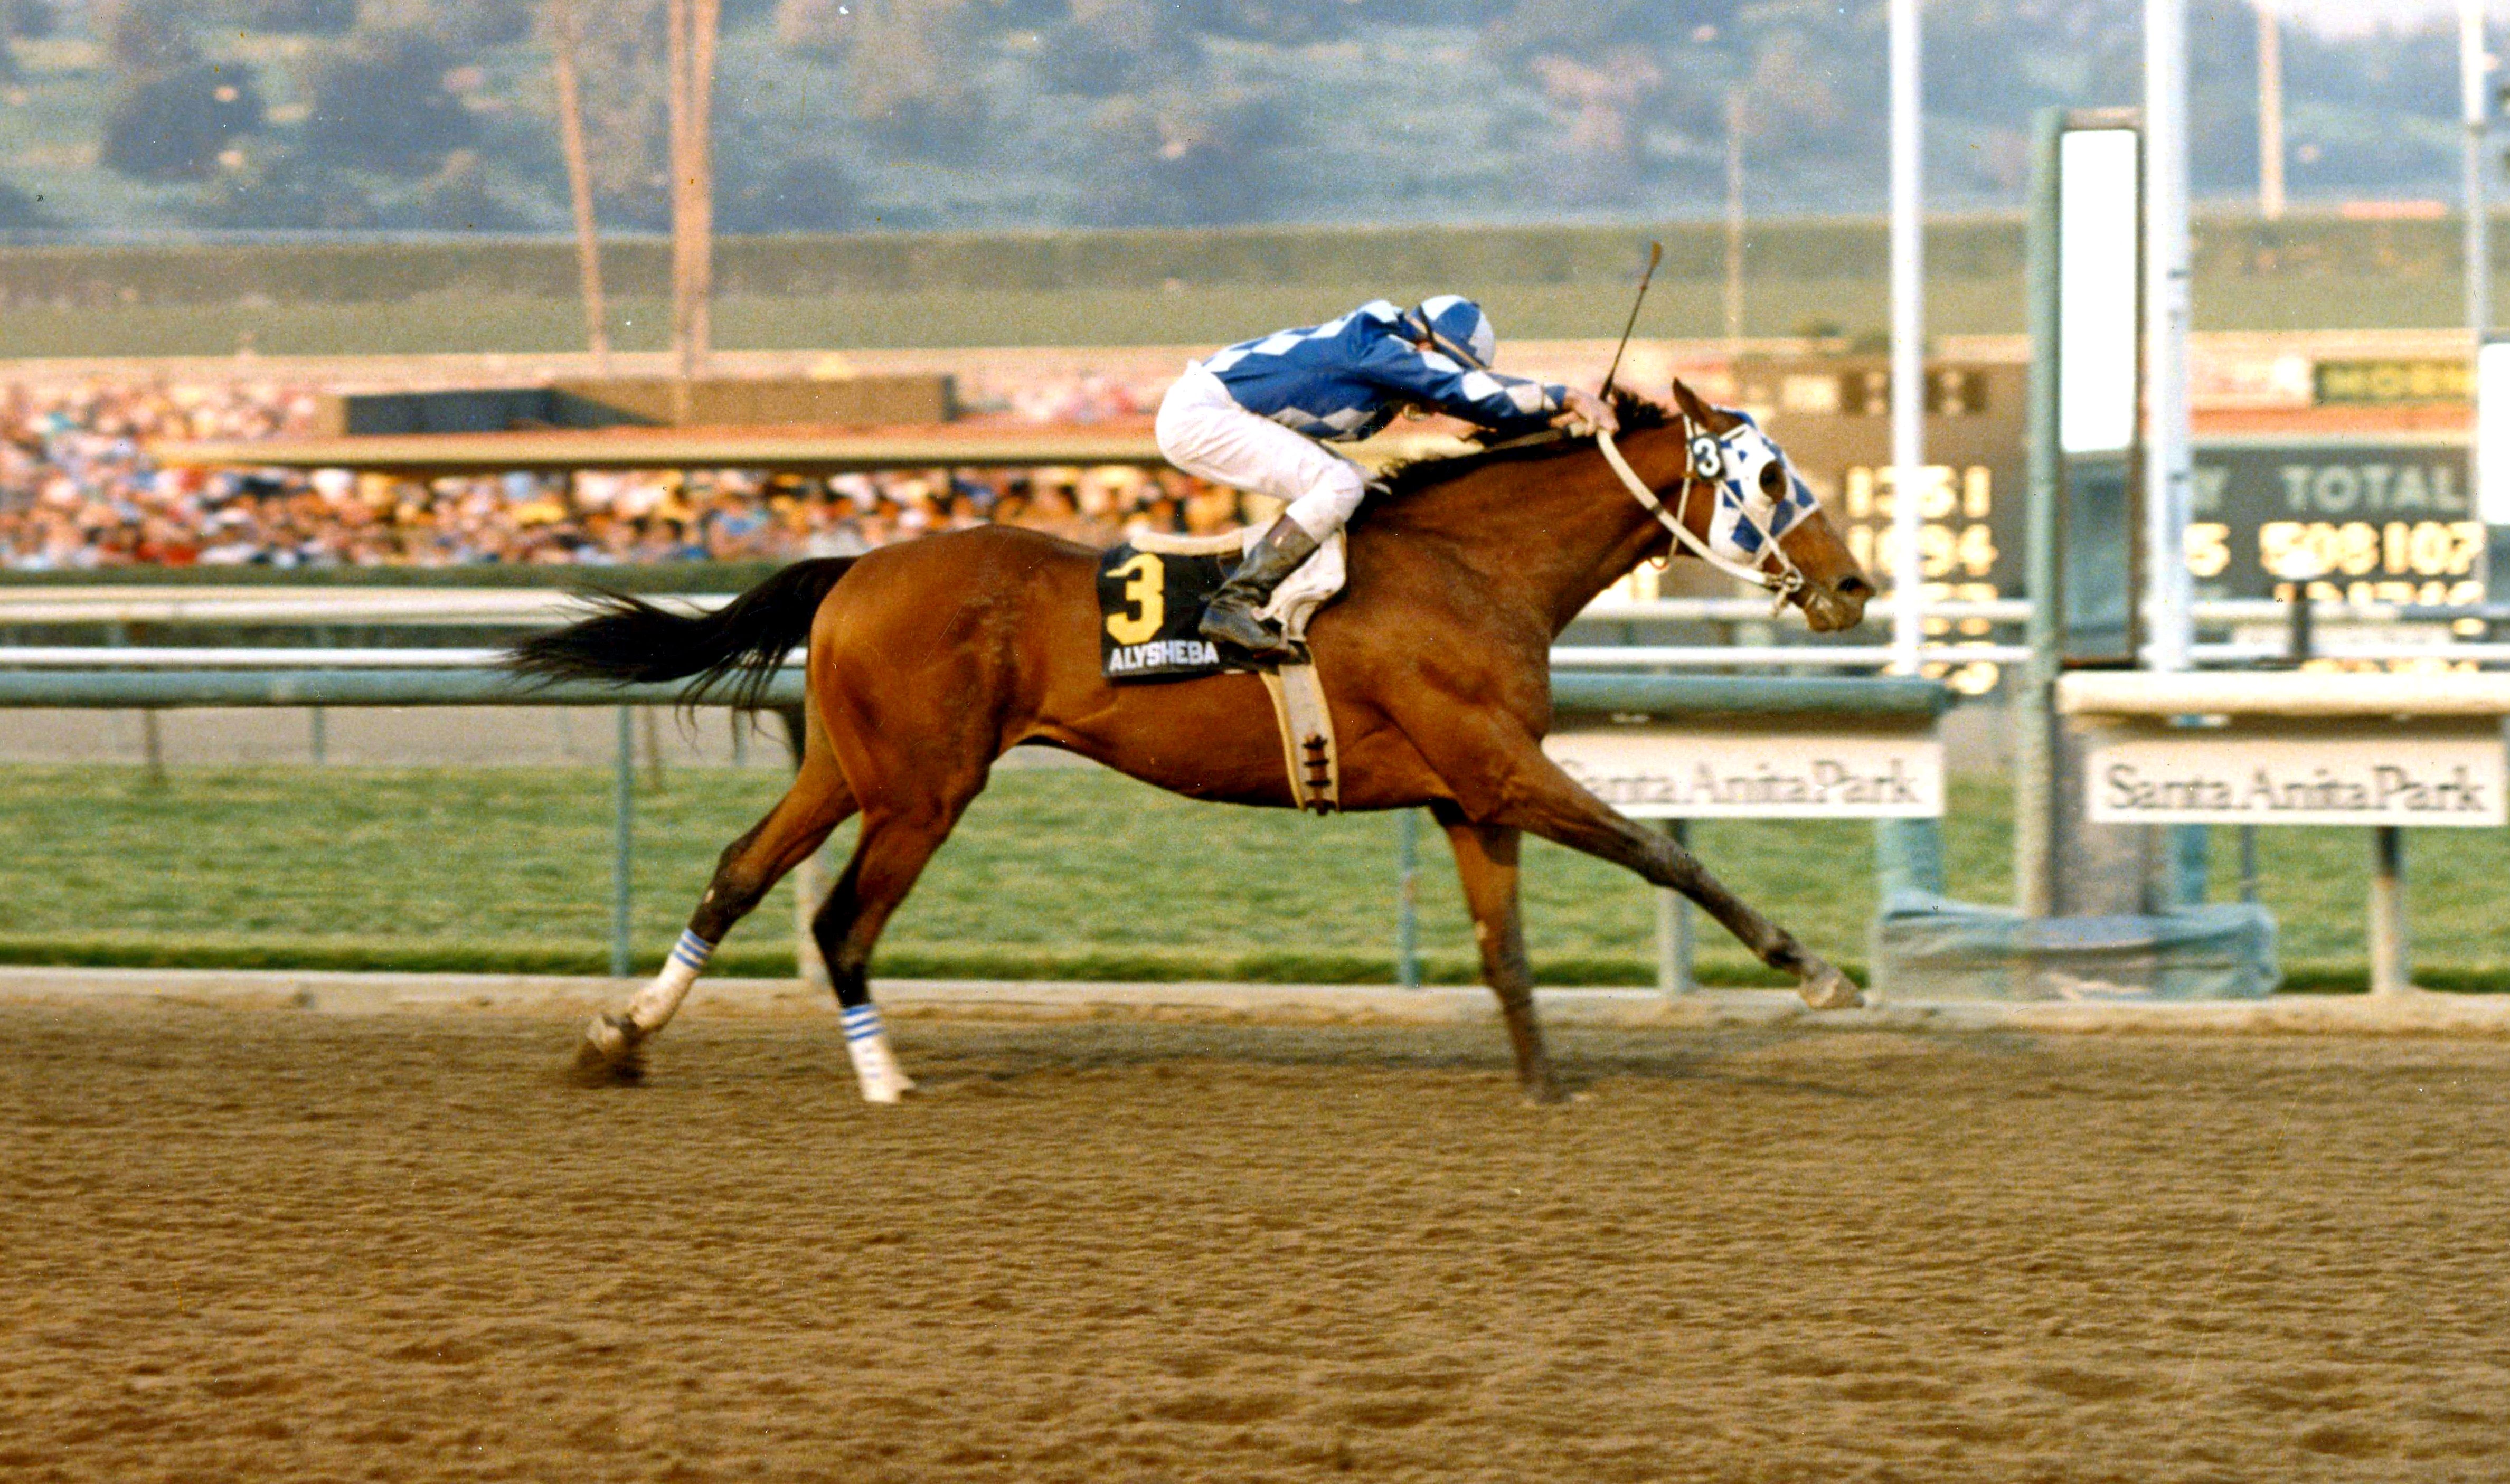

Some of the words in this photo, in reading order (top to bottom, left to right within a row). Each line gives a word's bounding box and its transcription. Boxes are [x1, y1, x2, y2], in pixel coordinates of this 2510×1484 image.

[1693, 437, 1722, 477] 3
[2280, 464, 2467, 512] TOTAL
[1106, 551, 1165, 645] 3
[1109, 639, 1220, 672] ALYSHEBA
[1682, 759, 1809, 805] Anita
[1810, 757, 1921, 805] Park
[2107, 763, 2238, 810] Santa
[2238, 765, 2369, 811] Anita
[2371, 764, 2491, 811] Park
